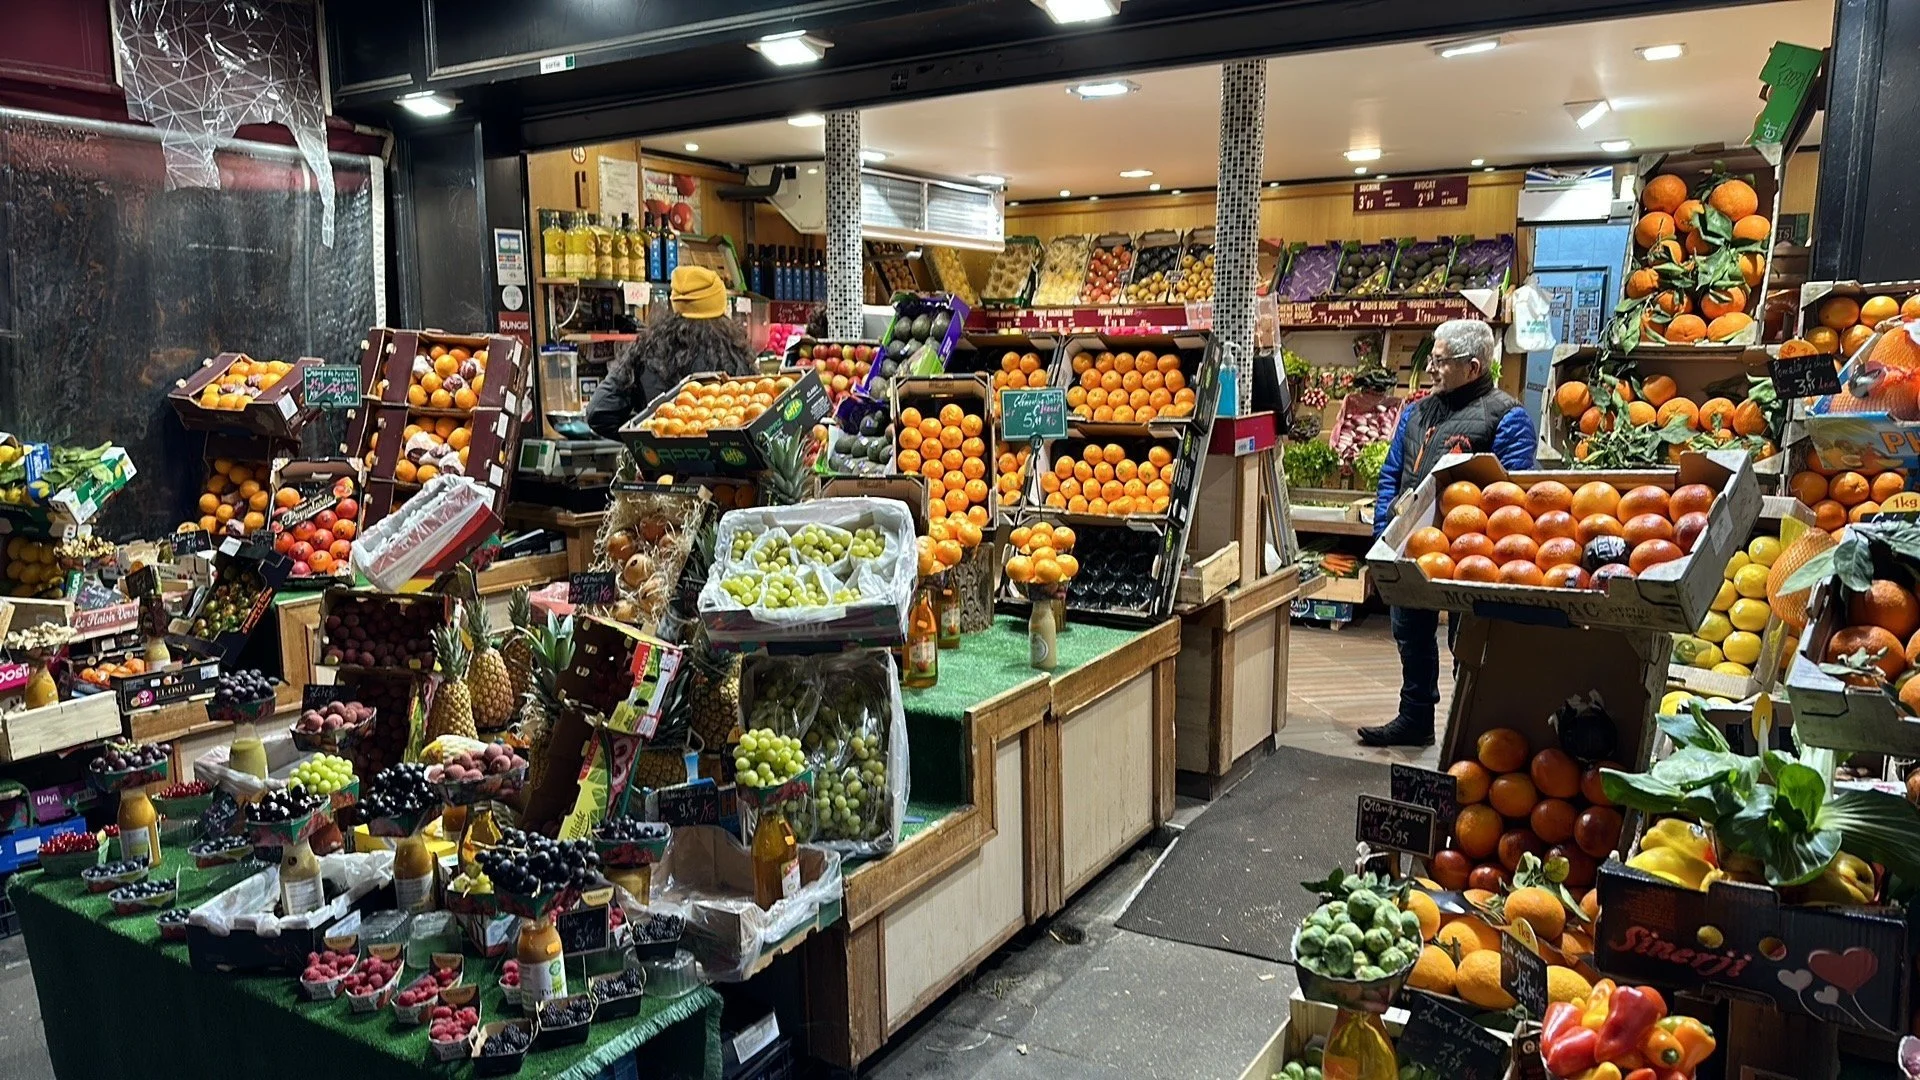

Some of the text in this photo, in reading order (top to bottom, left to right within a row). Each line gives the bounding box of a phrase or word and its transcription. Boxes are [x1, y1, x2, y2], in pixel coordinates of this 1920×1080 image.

[1413, 179, 1436, 190] AVOCAT
[1360, 301, 1399, 310] RADIS ROUGE
[500, 322, 529, 330] RUNGIS
[1892, 496, 1918, 509] 1kg
[74, 615, 86, 629] Le
[1517, 923, 1531, 944] 1kg
[1608, 925, 1752, 978] Sinerji
